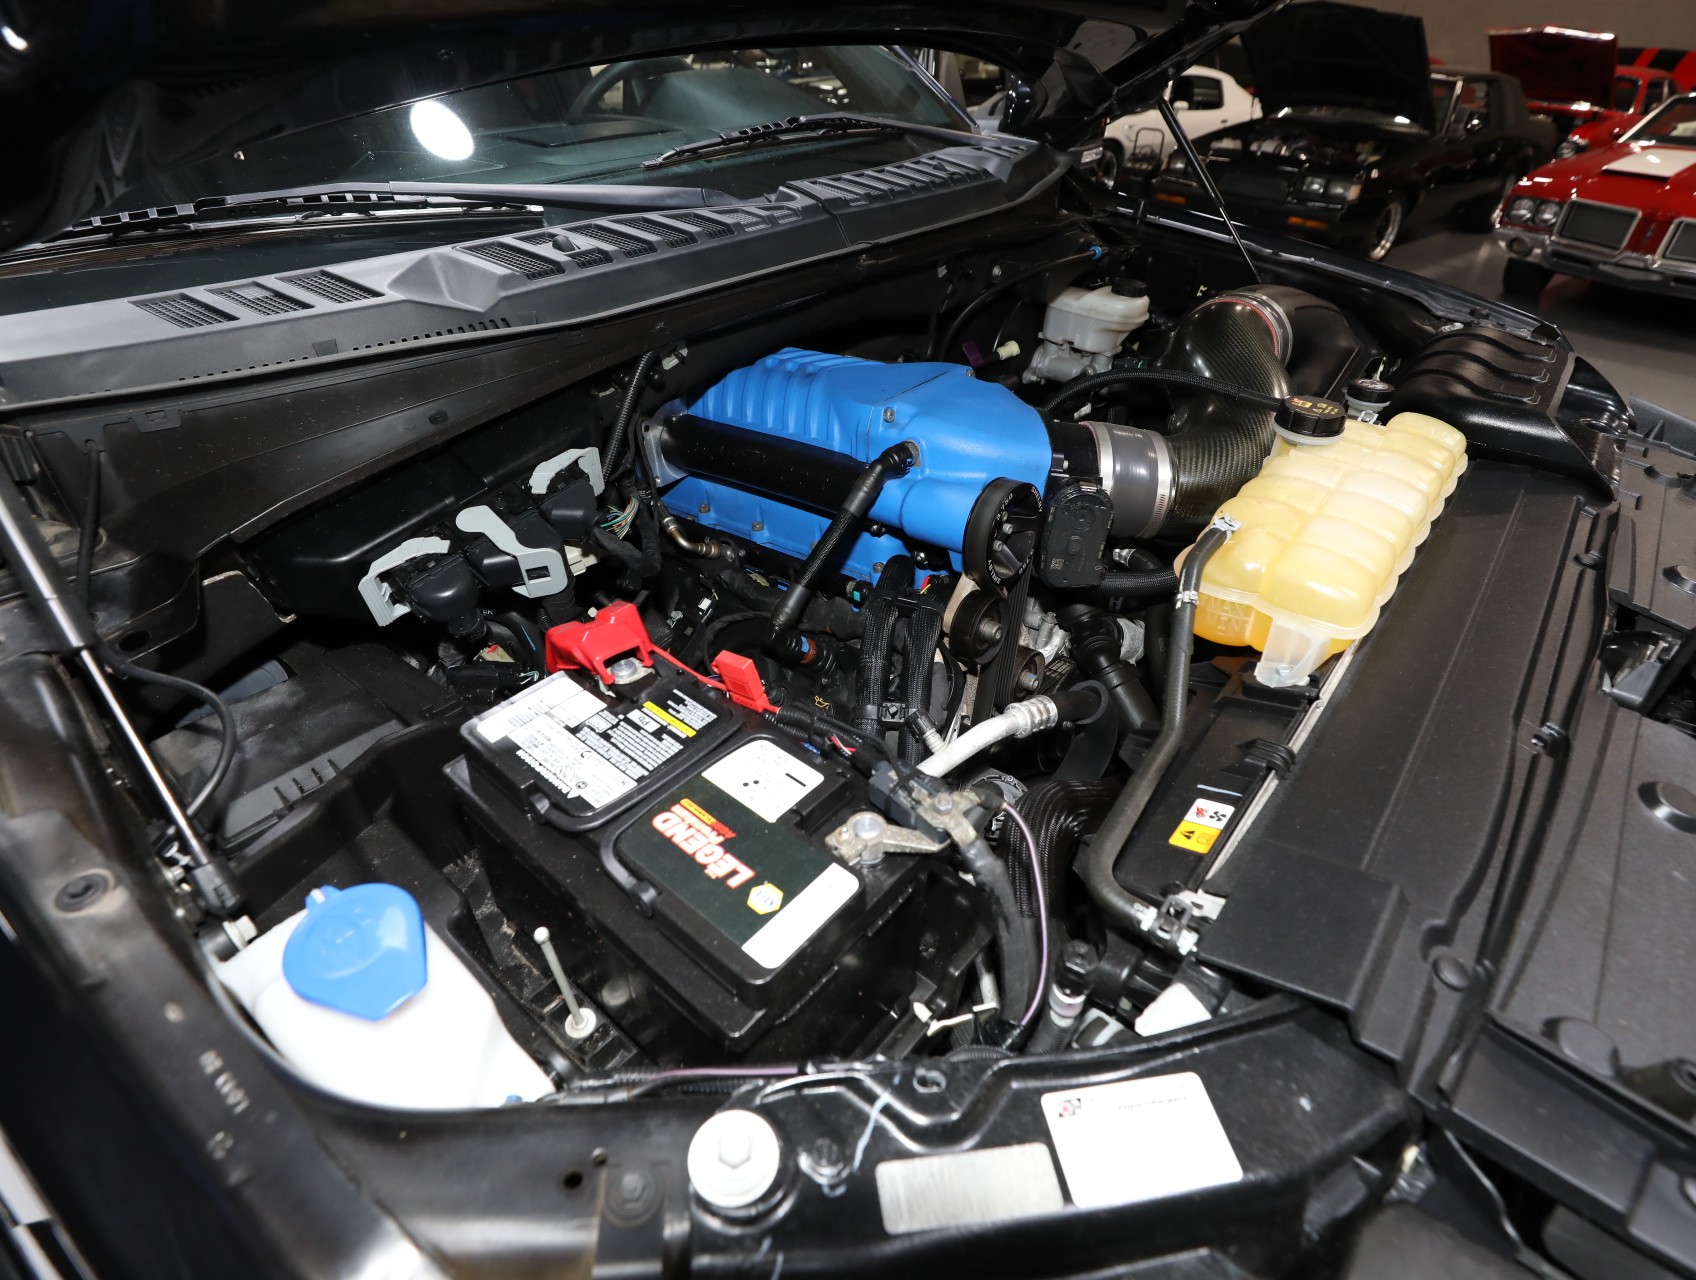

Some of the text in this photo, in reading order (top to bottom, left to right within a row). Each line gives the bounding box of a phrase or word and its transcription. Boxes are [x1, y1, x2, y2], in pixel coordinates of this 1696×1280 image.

[1031, 486, 1043, 512] SHELBY
[987, 559, 1001, 584] SHELBY
[638, 715, 649, 725] Pb
[652, 811, 756, 889] LEGEND
